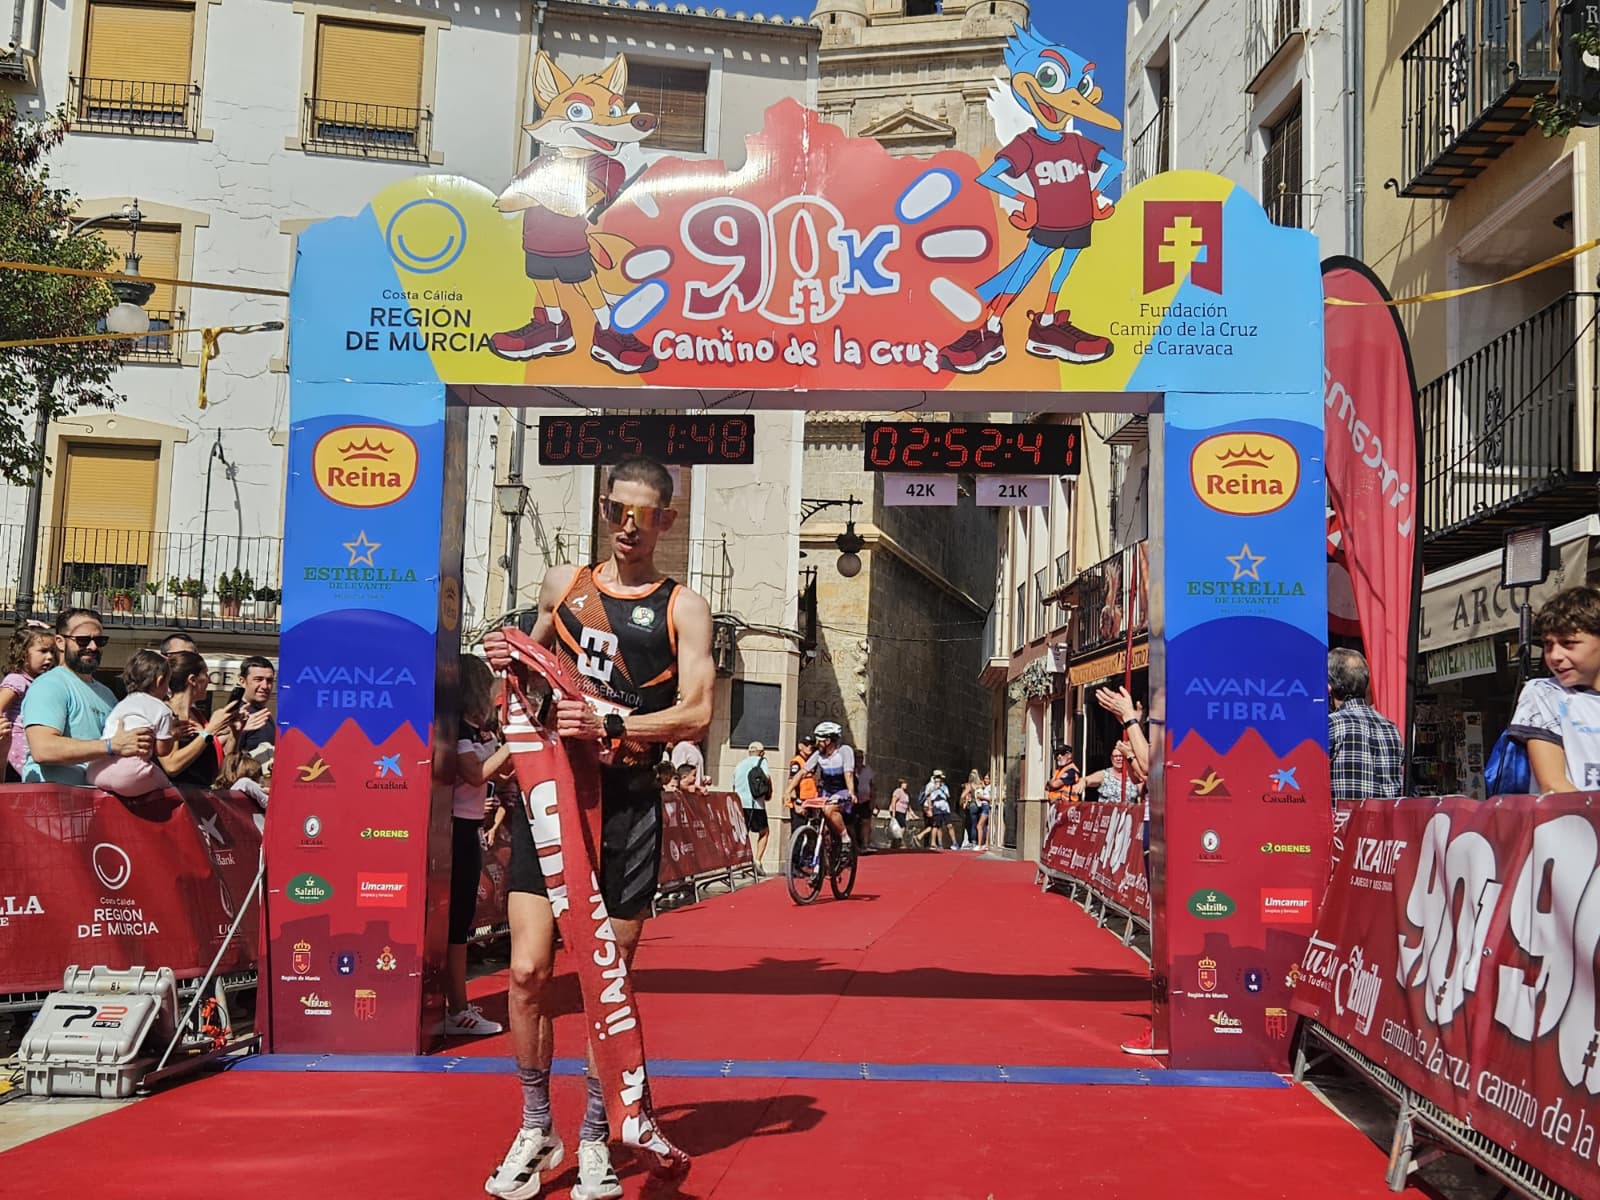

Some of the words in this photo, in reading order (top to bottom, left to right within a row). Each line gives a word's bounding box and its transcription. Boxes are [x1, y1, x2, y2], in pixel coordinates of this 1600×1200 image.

[382, 290, 418, 301] Costa
[423, 289, 463, 302] Cálida
[370, 305, 471, 328] REGIÓN
[1140, 303, 1227, 318] Fundación
[1110, 322, 1172, 336] Camino
[1177, 322, 1196, 336] de
[1200, 322, 1215, 336] la
[1219, 323, 1257, 337] Cruz
[346, 332, 378, 351] DE
[389, 332, 491, 352] MURCIA
[653, 327, 774, 364] Camino
[783, 337, 818, 367] de
[833, 326, 862, 364] la
[1134, 340, 1153, 355] de
[1158, 342, 1233, 355] Caravaca
[871, 426, 1075, 467] 02:52:41
[328, 467, 402, 488] Reina
[1207, 474, 1284, 495] Reina
[906, 482, 936, 498] 42K
[999, 483, 1028, 498] 21K
[304, 567, 418, 582] ESTRELLA
[345, 582, 392, 591] LEVANTE
[1187, 582, 1305, 596] ESTRELLA
[297, 666, 416, 686] AVANZA
[1185, 677, 1308, 697] AVANZA
[317, 690, 393, 709] FIBRA
[1207, 702, 1286, 721] FIBRA
[366, 780, 408, 790] CaixaBank
[373, 830, 409, 838] ORENES
[1274, 844, 1311, 853] ORENES
[294, 887, 325, 896] Salzillo
[361, 882, 404, 891] Limcamar
[1196, 903, 1228, 912] Salzillo
[1265, 898, 1309, 907] Limcamar
[94, 907, 143, 922] REGIÓN
[78, 924, 102, 938] DE
[107, 922, 159, 936] MURCIA
[1425, 1037, 1444, 1075] la
[1477, 1070, 1538, 1129] camino
[1541, 1097, 1572, 1146] de
[1571, 1108, 1595, 1160] la
